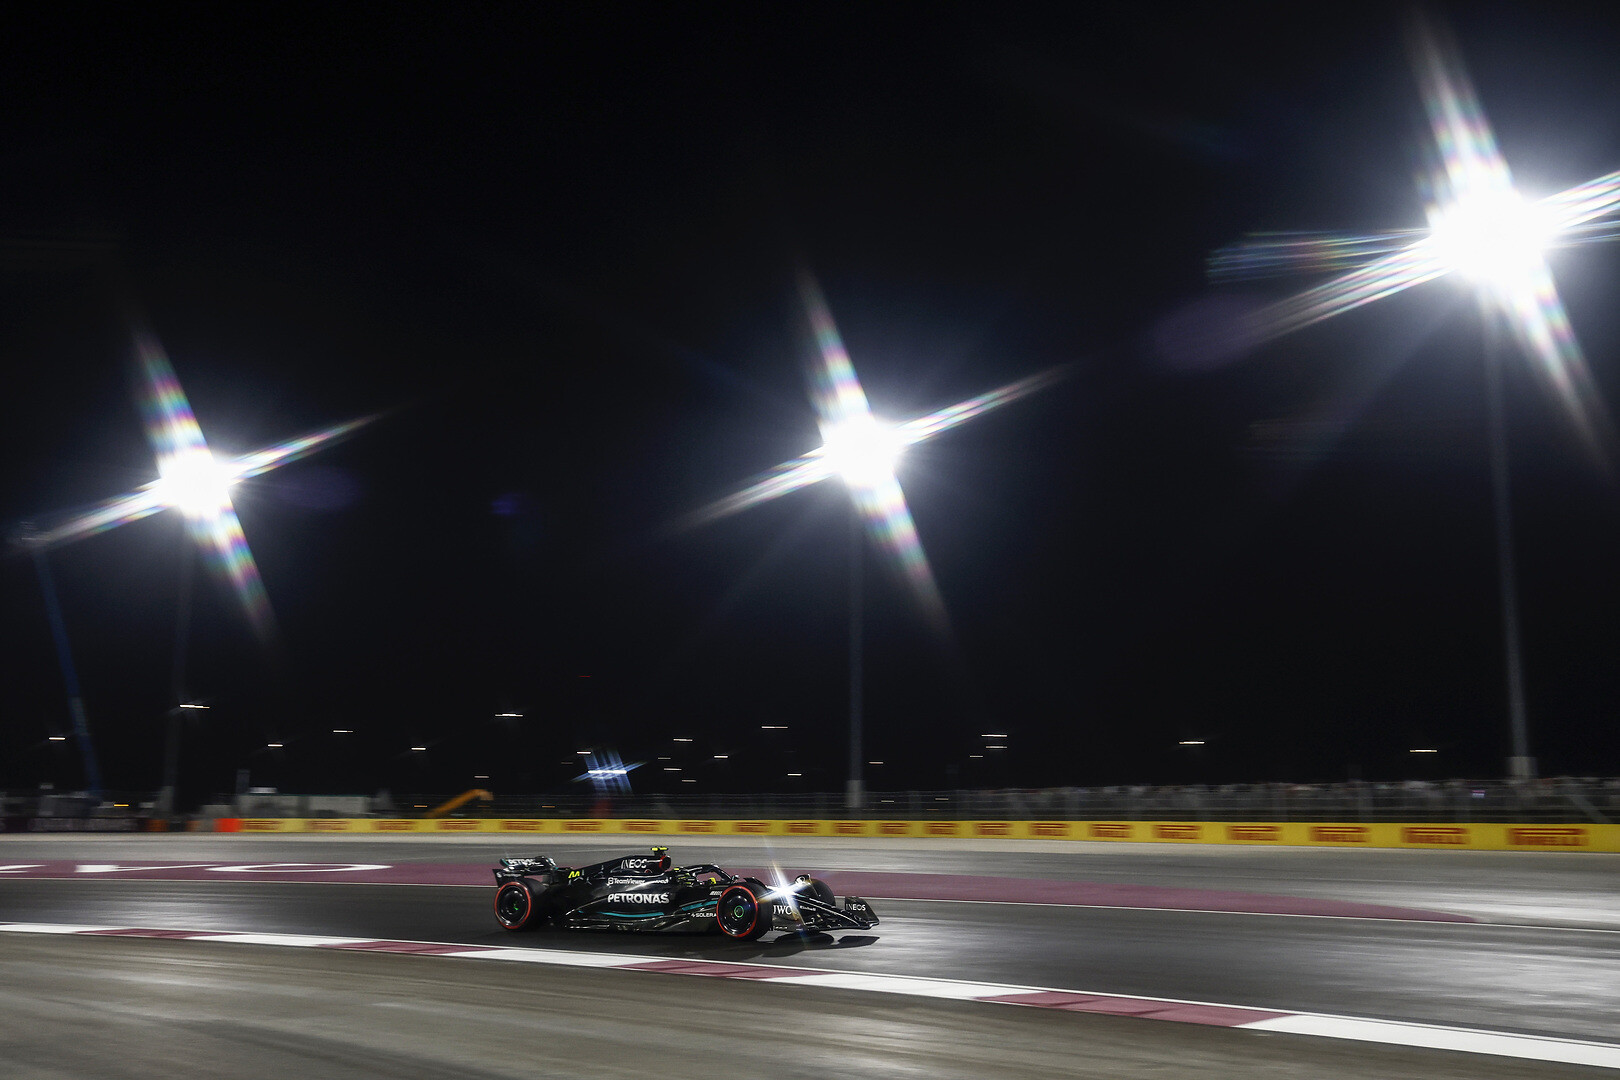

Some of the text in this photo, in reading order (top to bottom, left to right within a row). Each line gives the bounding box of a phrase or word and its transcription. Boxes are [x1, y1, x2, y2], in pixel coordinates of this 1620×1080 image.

[621, 858, 648, 869] INEOS
[607, 893, 670, 904] PETRONAS
[773, 904, 792, 915] IWC
